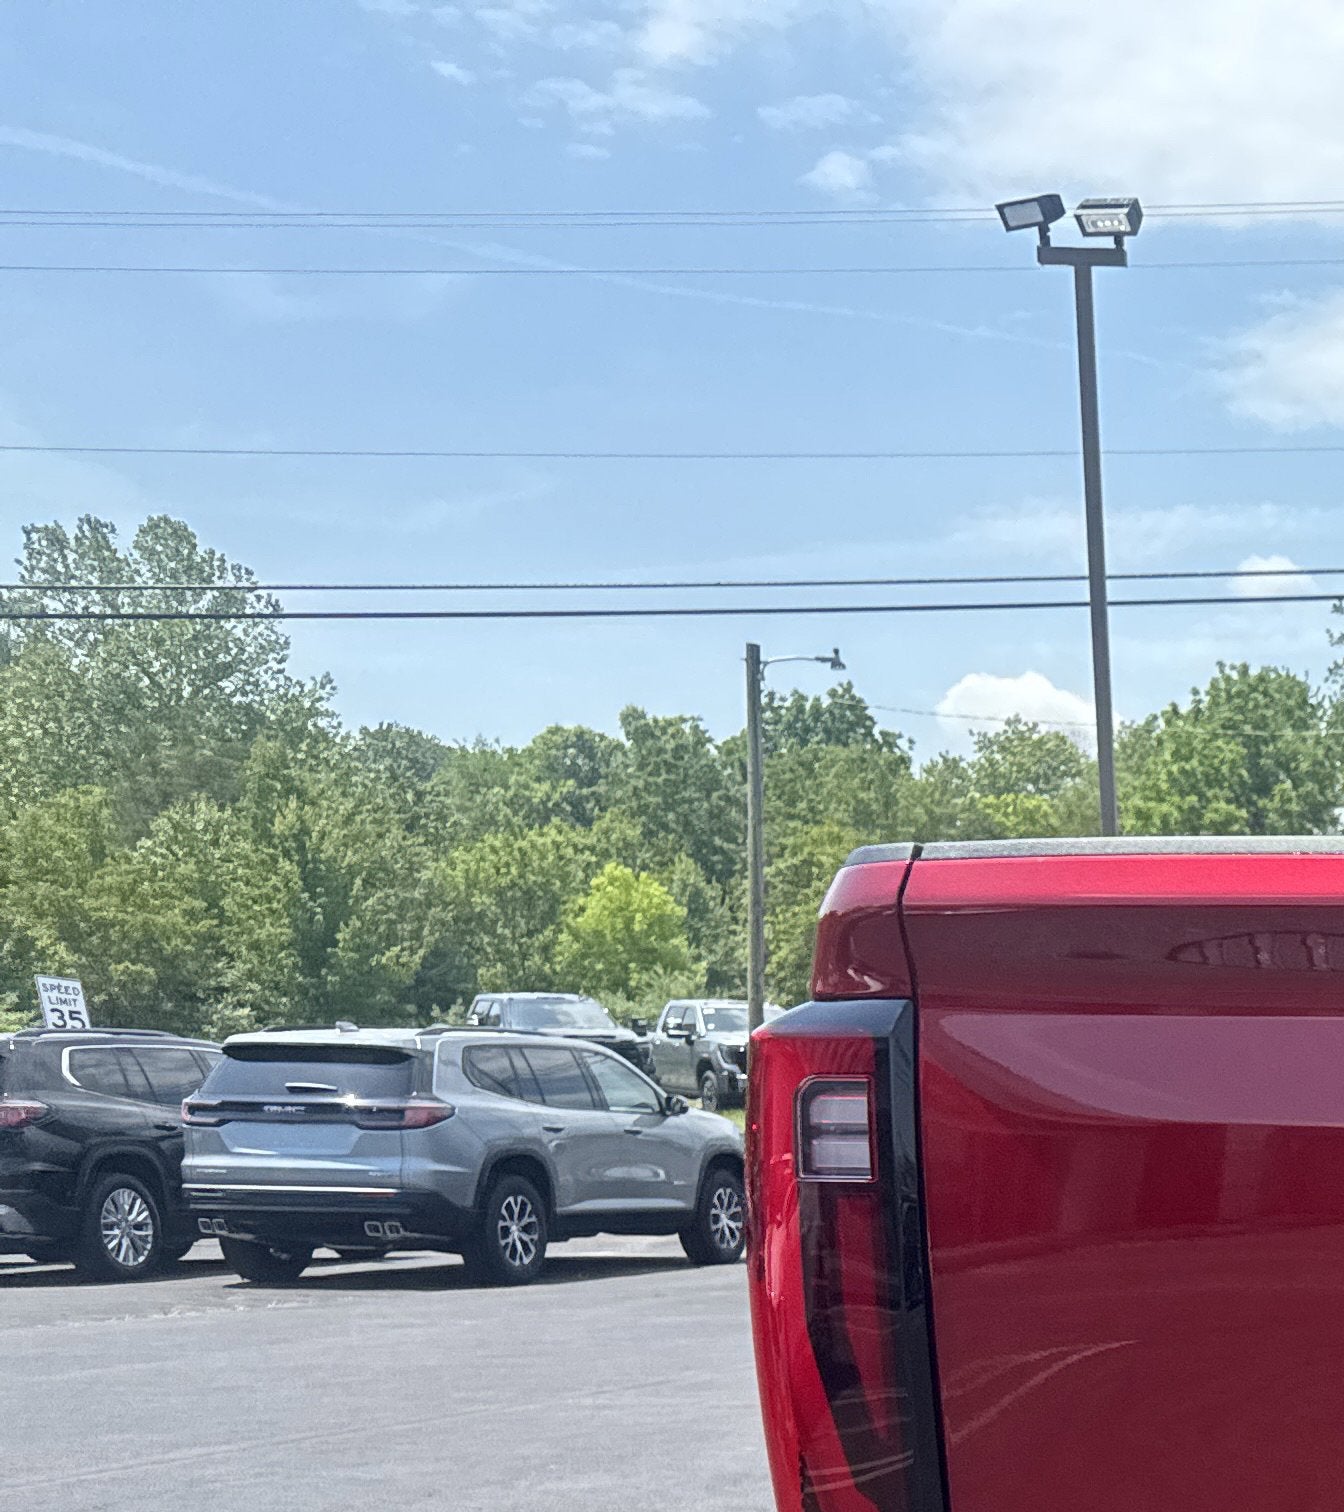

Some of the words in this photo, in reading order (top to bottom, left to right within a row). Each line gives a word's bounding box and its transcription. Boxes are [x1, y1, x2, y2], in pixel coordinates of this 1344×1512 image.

[41, 982, 81, 996] SPEED
[47, 995, 78, 1007] LIMIT
[49, 1008, 86, 1029] 35
